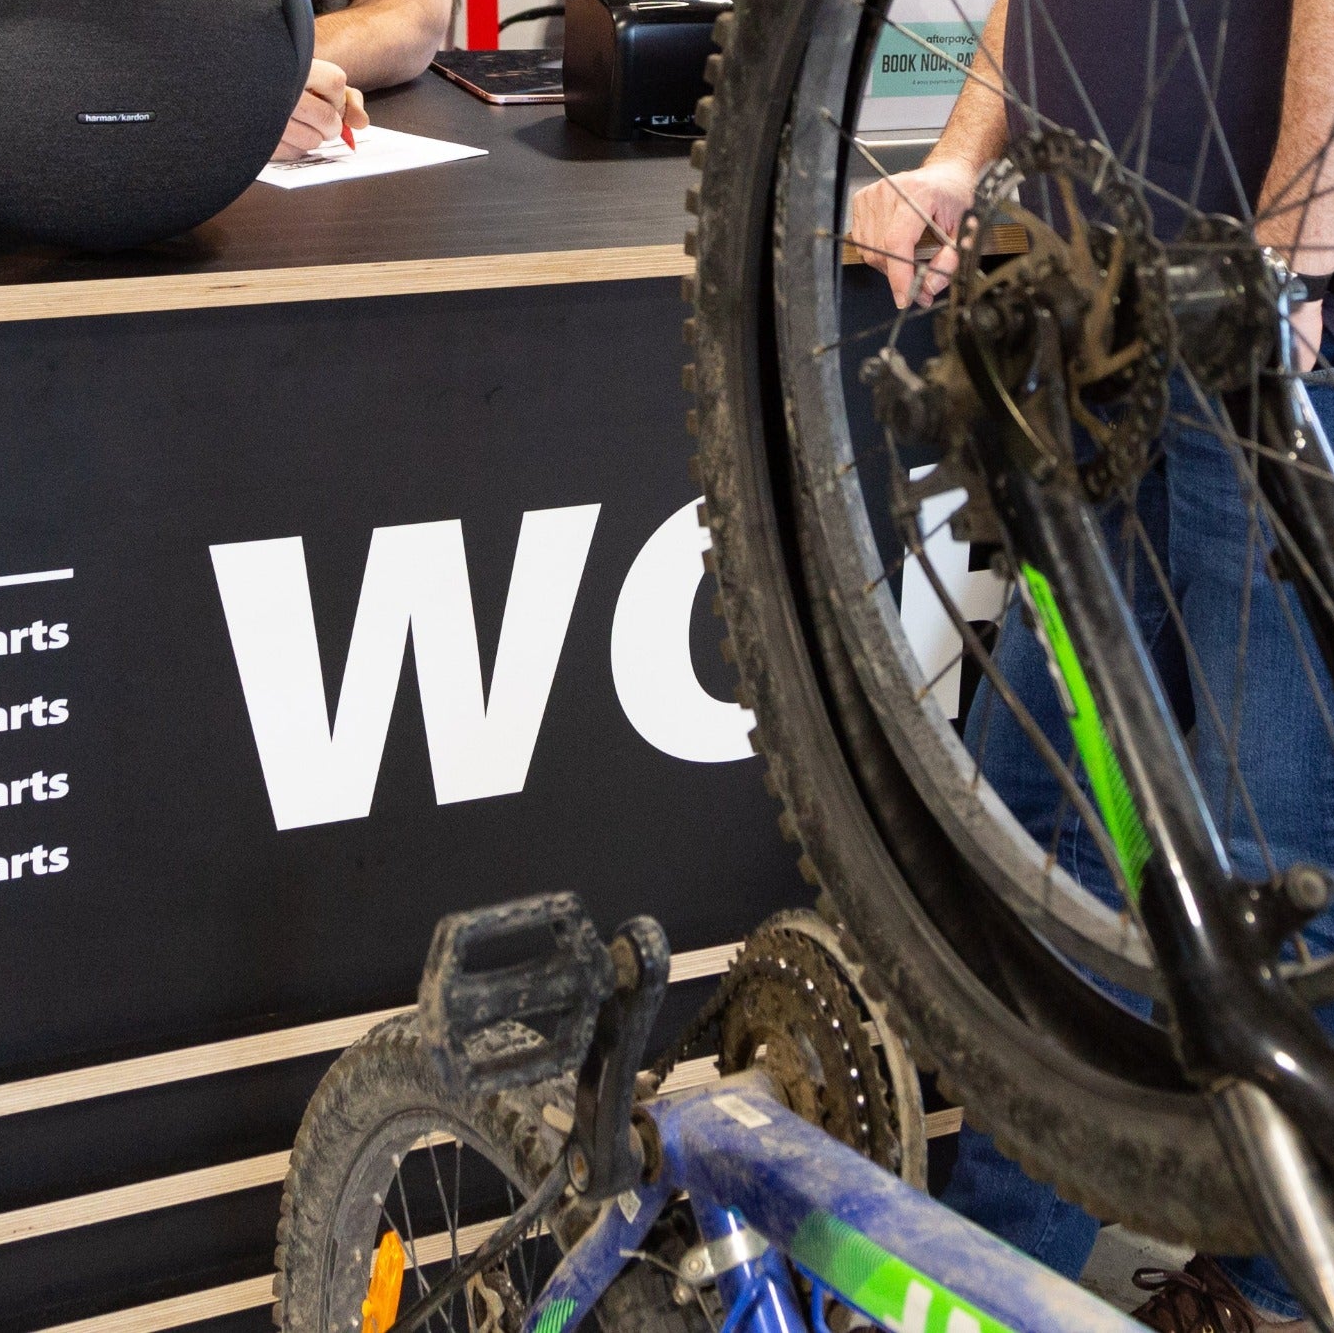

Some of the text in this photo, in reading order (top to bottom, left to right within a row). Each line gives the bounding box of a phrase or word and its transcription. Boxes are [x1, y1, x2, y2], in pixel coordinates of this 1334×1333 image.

[926, 34, 967, 45] afterpay
[882, 54, 917, 73] BOOK
[85, 113, 150, 122] harman/kardon
